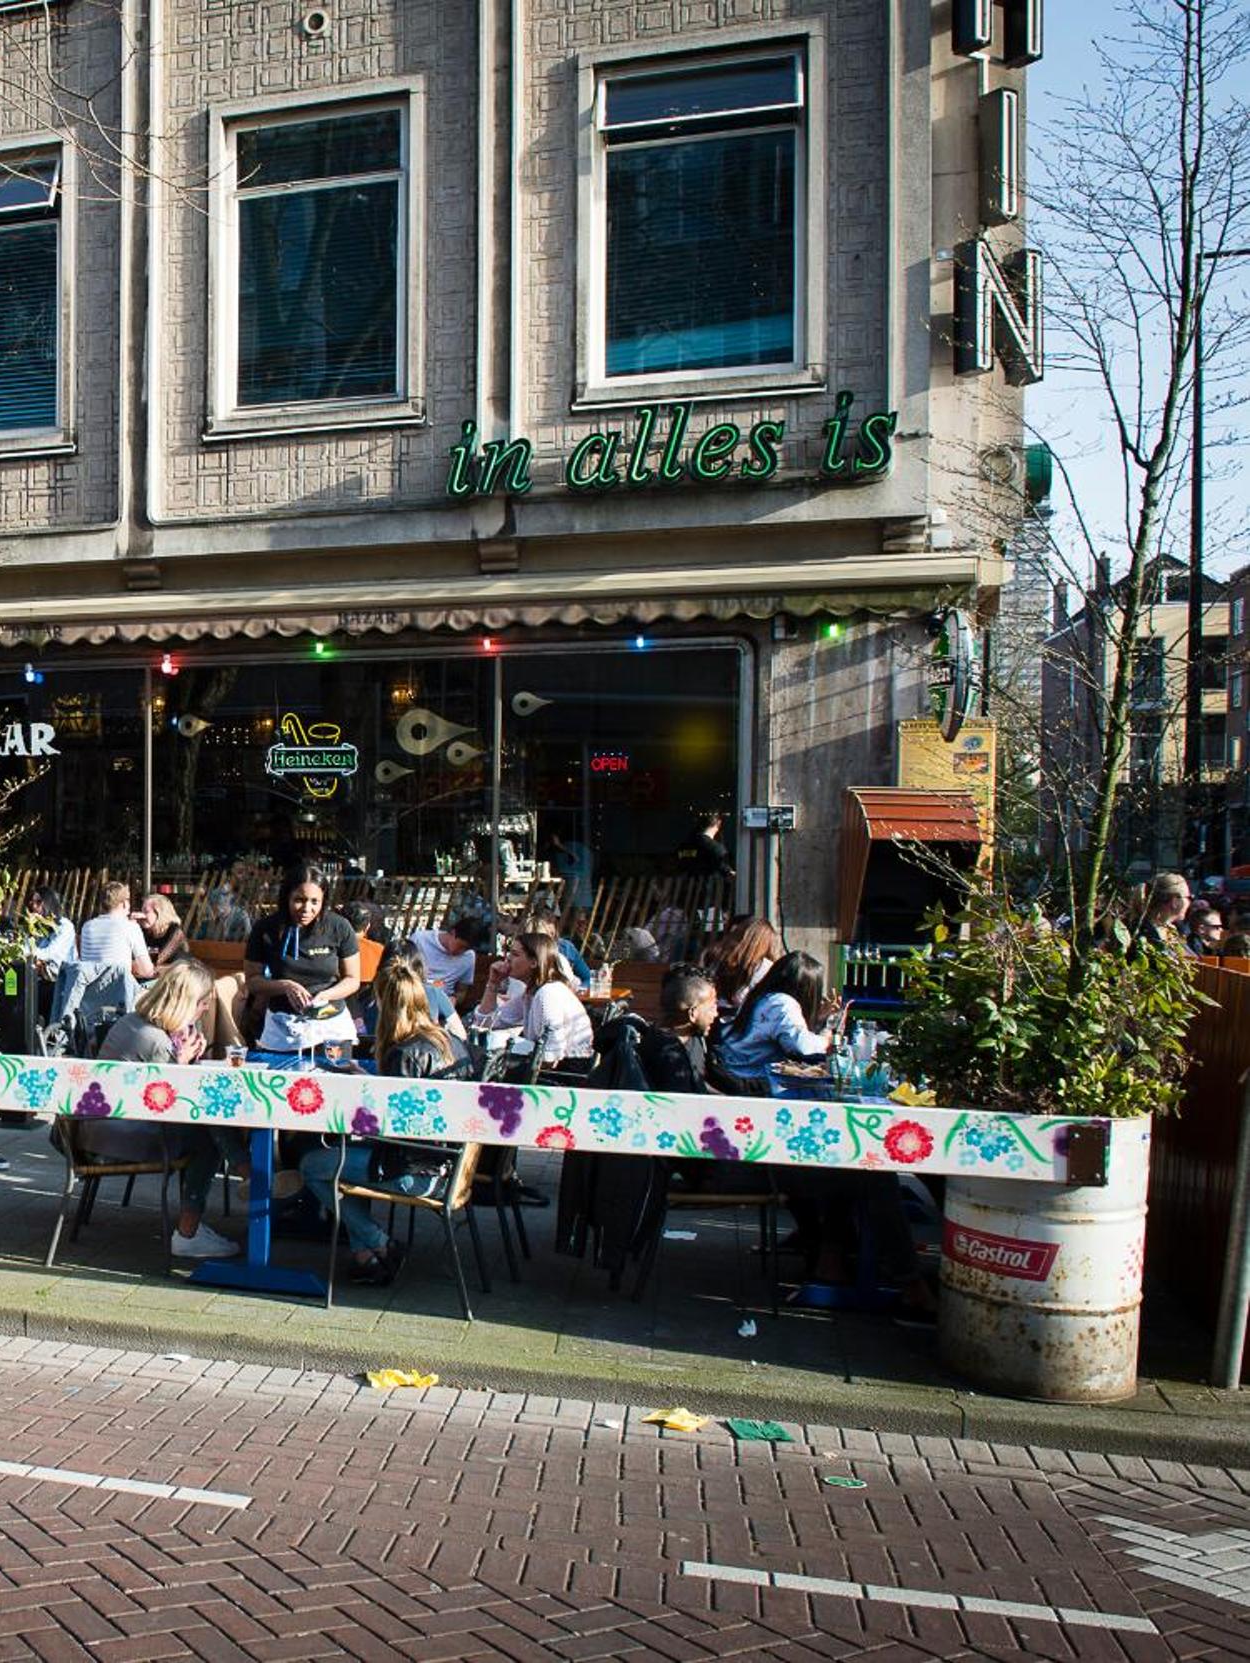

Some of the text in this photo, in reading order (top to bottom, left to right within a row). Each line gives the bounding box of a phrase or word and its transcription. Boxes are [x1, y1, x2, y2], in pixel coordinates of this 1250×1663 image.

[447, 390, 898, 497] in alles is
[272, 750, 354, 768] Heineken
[591, 757, 628, 772] OPEN
[968, 1239, 1032, 1270] Castrol
